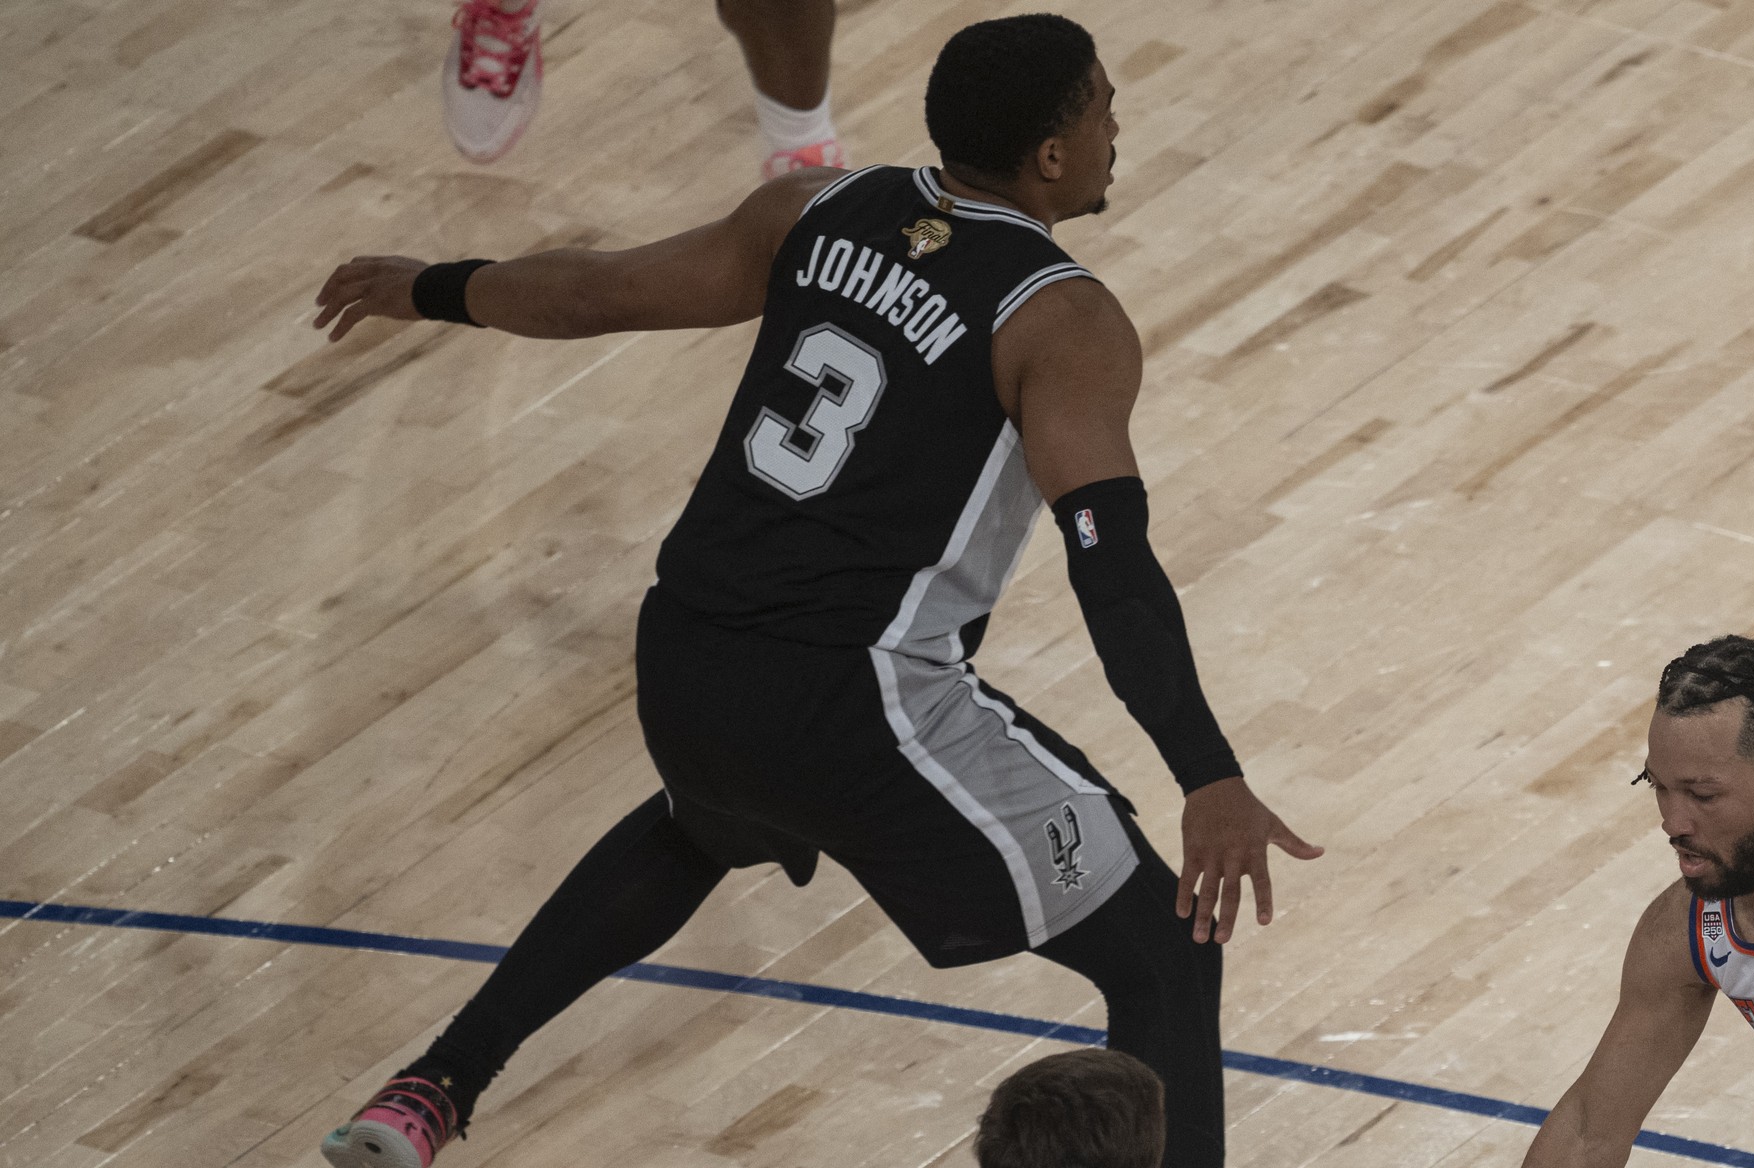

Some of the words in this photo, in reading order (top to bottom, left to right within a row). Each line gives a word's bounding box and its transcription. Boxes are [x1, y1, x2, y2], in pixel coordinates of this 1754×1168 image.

[796, 235, 967, 366] JOHNSON
[743, 321, 888, 502] 3
[1703, 926, 1723, 935] 250
[1704, 914, 1720, 922] USA
